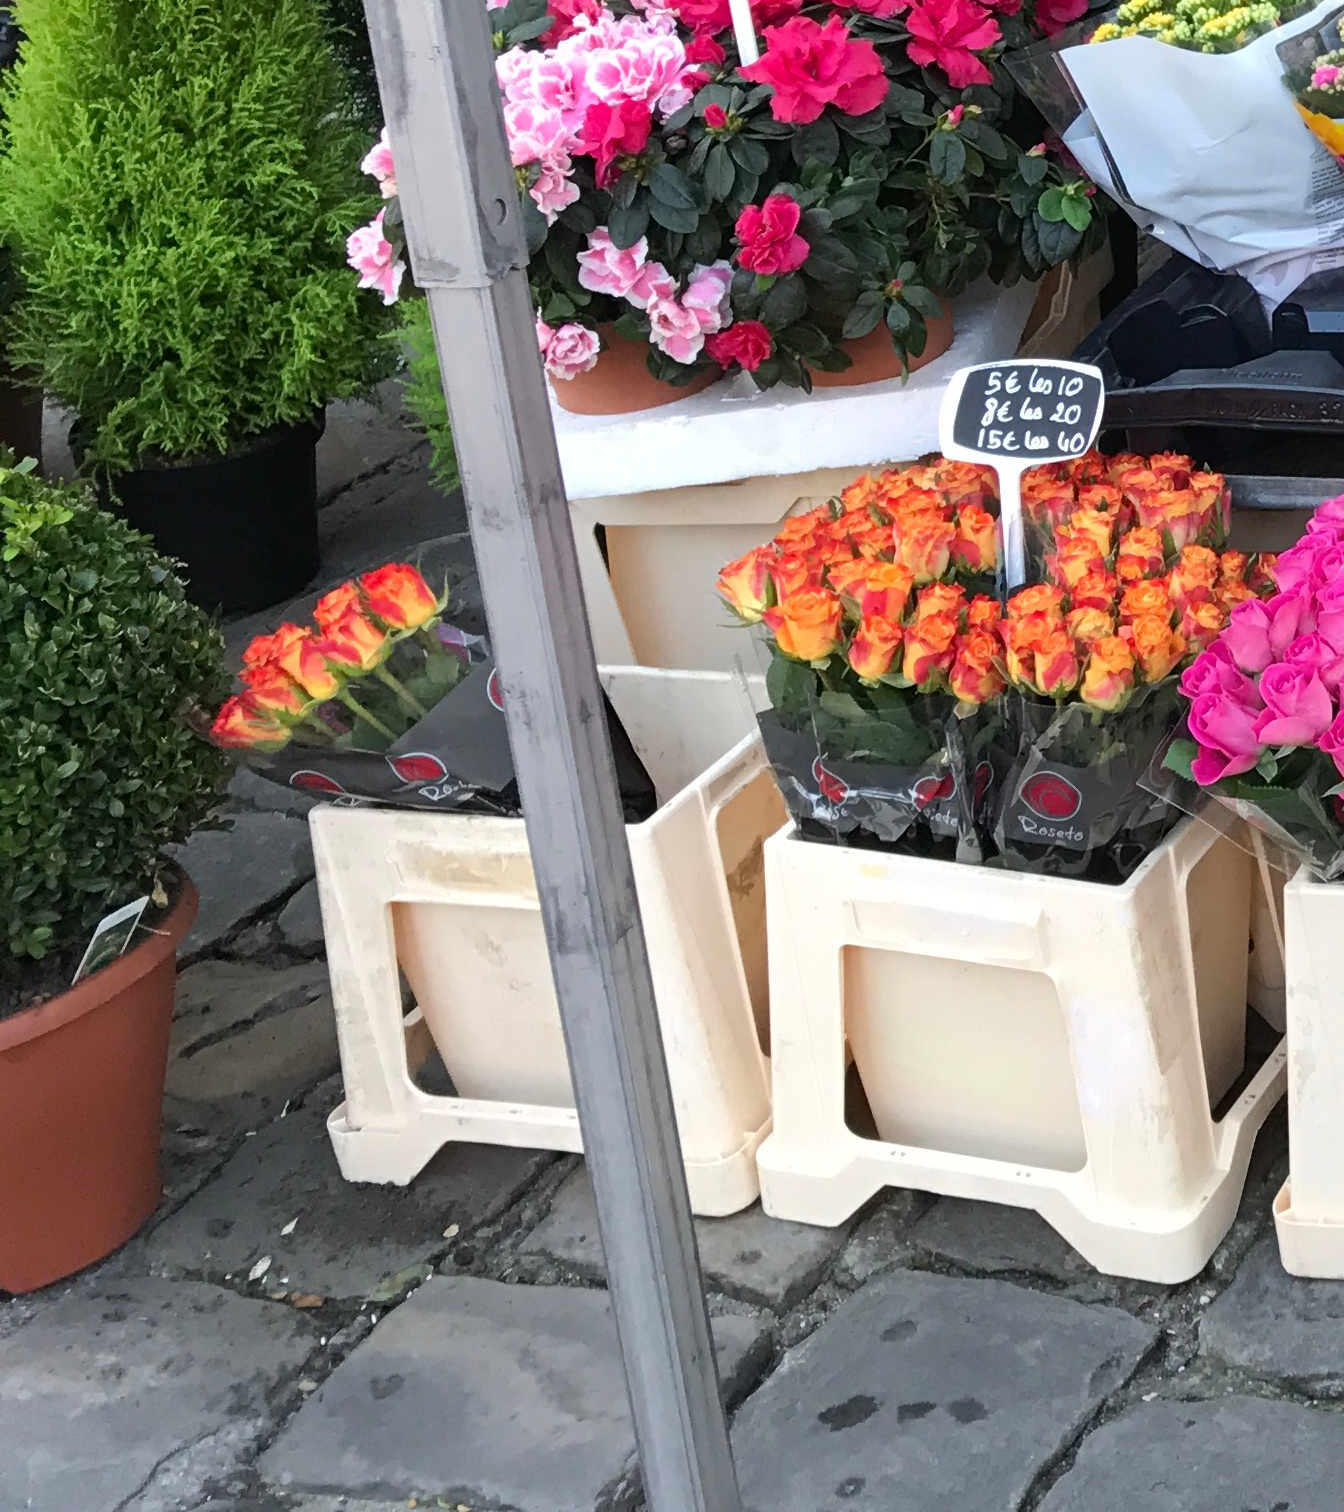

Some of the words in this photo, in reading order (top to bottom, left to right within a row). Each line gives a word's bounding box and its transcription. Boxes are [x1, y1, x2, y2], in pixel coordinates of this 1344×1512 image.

[984, 370, 1022, 396] 5€
[1057, 375, 1084, 397] 10
[980, 397, 1014, 427] 8€
[1049, 402, 1082, 426] 20
[976, 428, 1021, 451] 15€
[1057, 431, 1086, 453] 40
[1017, 814, 1084, 842] Roseto
